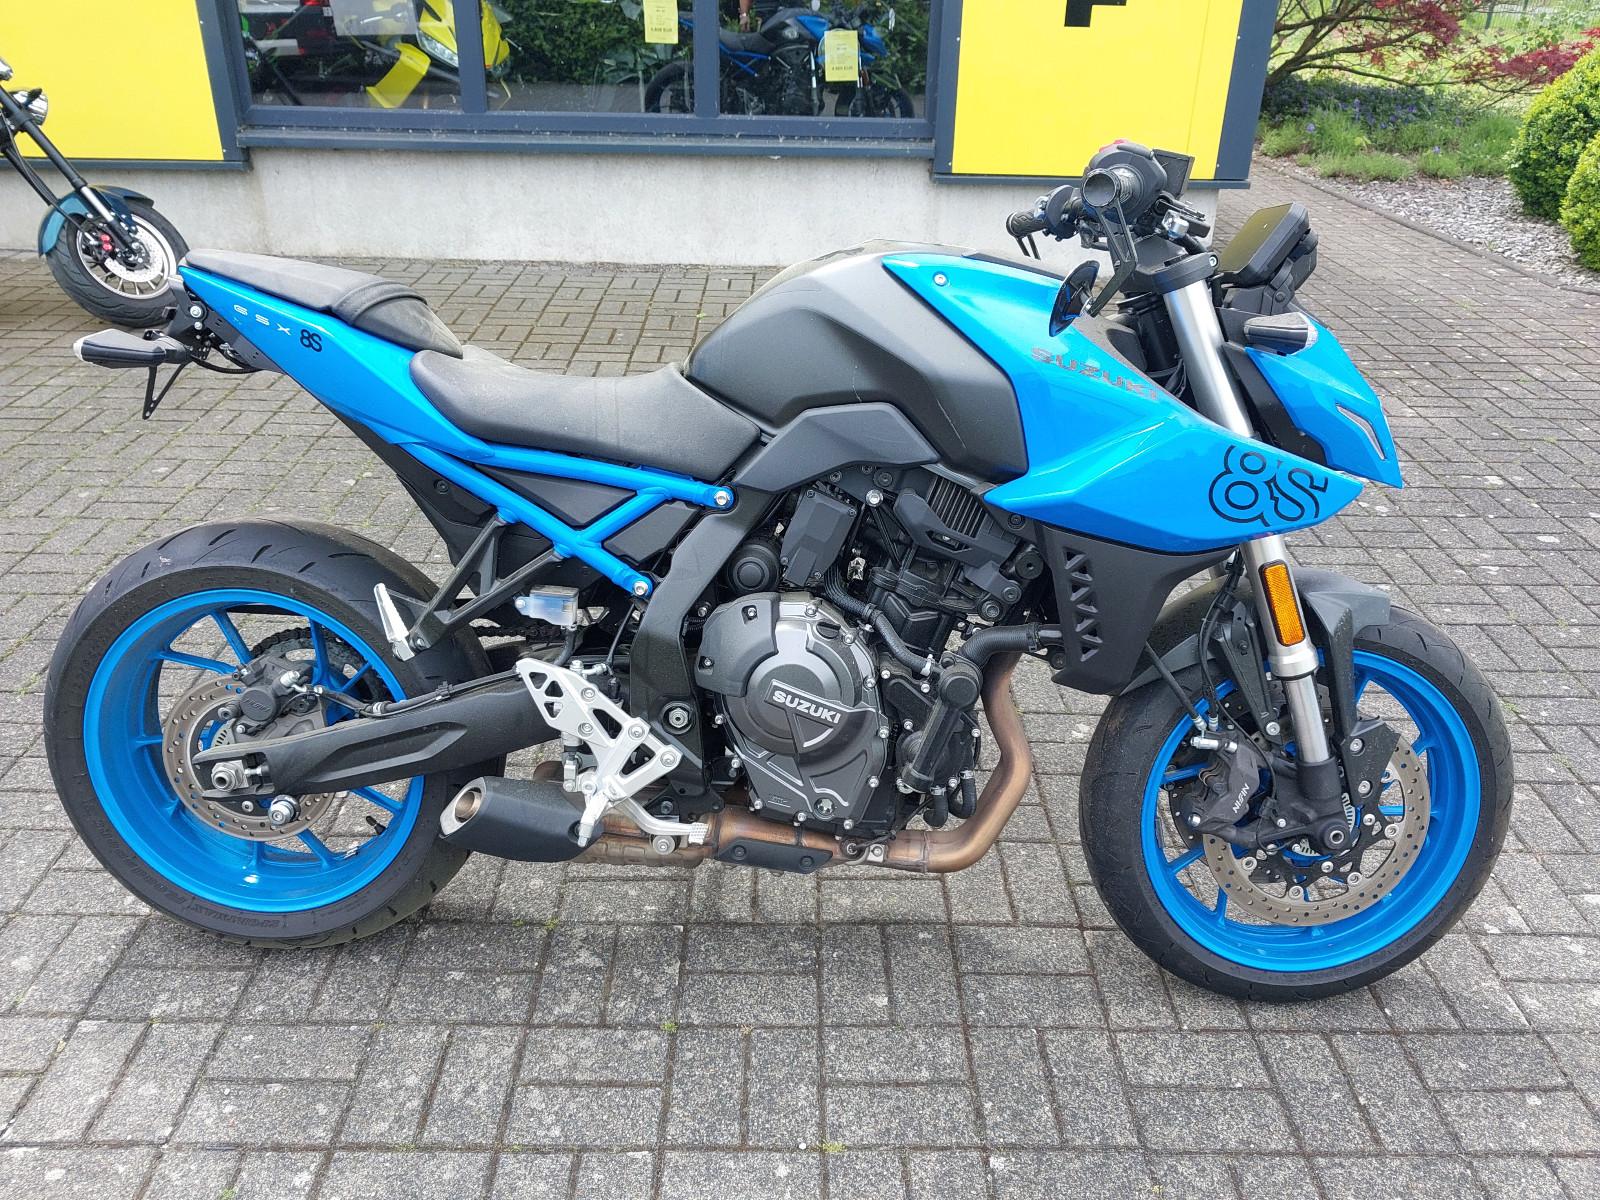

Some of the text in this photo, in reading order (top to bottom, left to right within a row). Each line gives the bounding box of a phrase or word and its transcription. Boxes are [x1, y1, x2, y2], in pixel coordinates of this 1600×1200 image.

[300, 328, 323, 353] 8S
[1031, 347, 1158, 401] SUZUKI
[1208, 444, 1329, 527] 8S
[772, 690, 842, 724] SUZUKI
